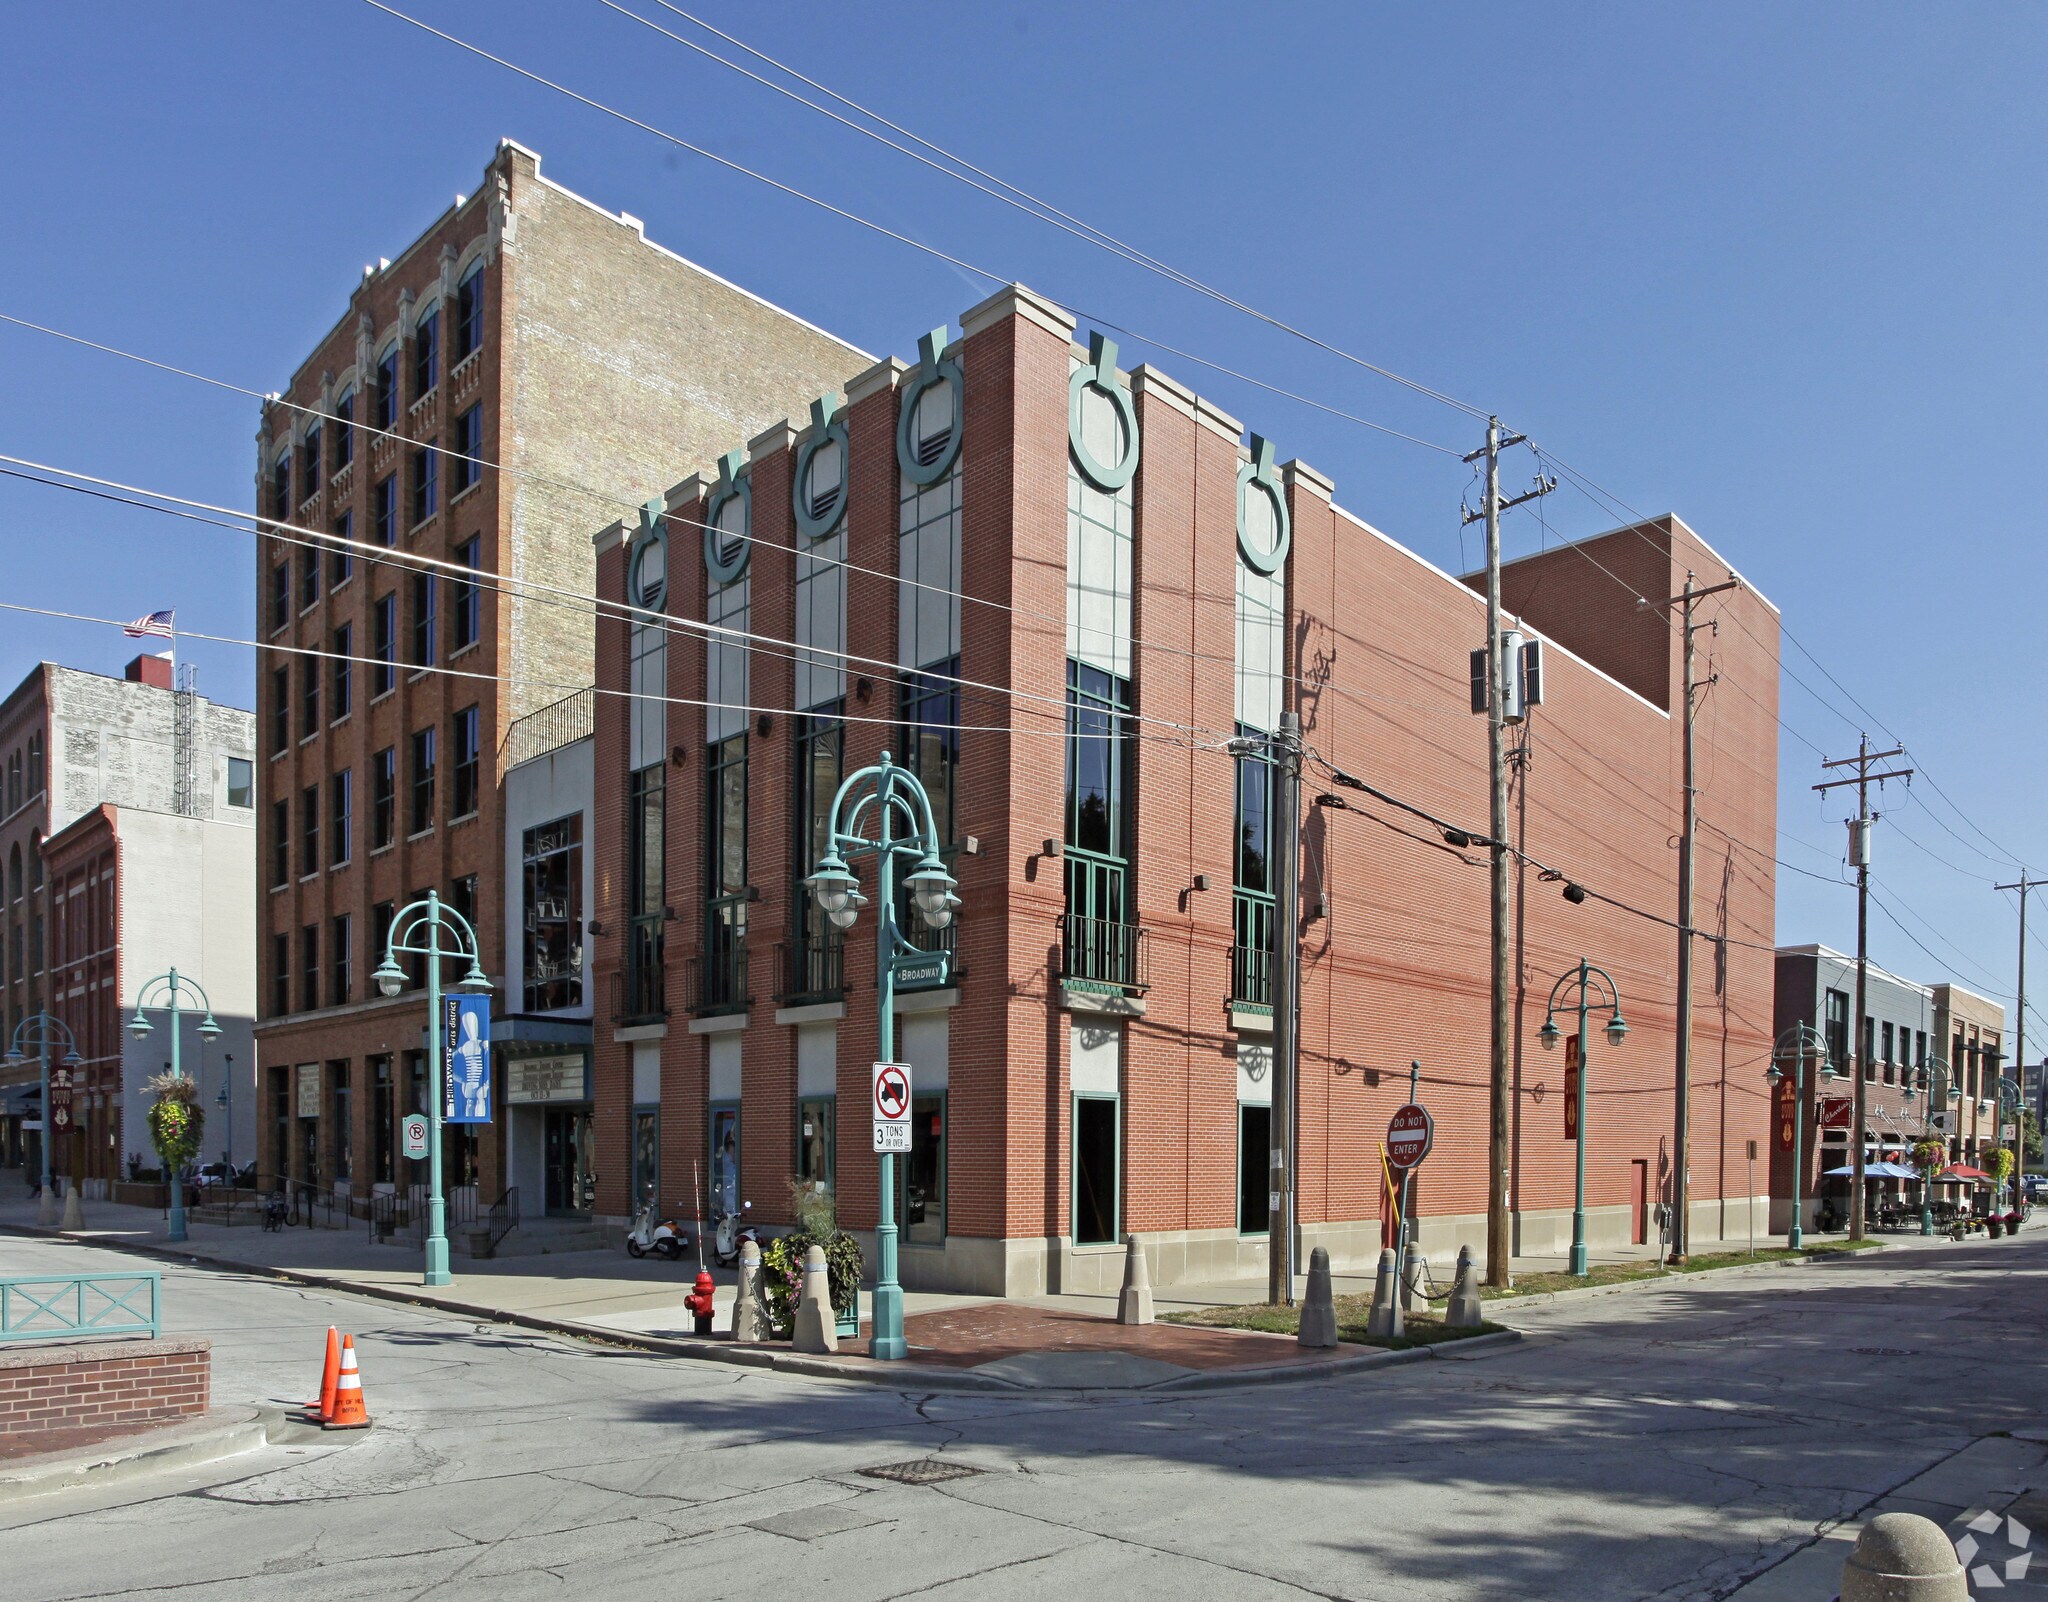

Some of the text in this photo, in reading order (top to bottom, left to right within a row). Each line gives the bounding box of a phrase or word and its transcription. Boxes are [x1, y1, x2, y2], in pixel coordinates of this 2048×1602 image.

[901, 966, 940, 981] BROADWAY
[1394, 1116, 1423, 1127] DO NOT
[876, 1128, 884, 1145] 3
[885, 1125, 904, 1137] TONS
[886, 1138, 892, 1147] OR
[893, 1138, 903, 1148] OVER
[1394, 1144, 1417, 1154] ENTER
